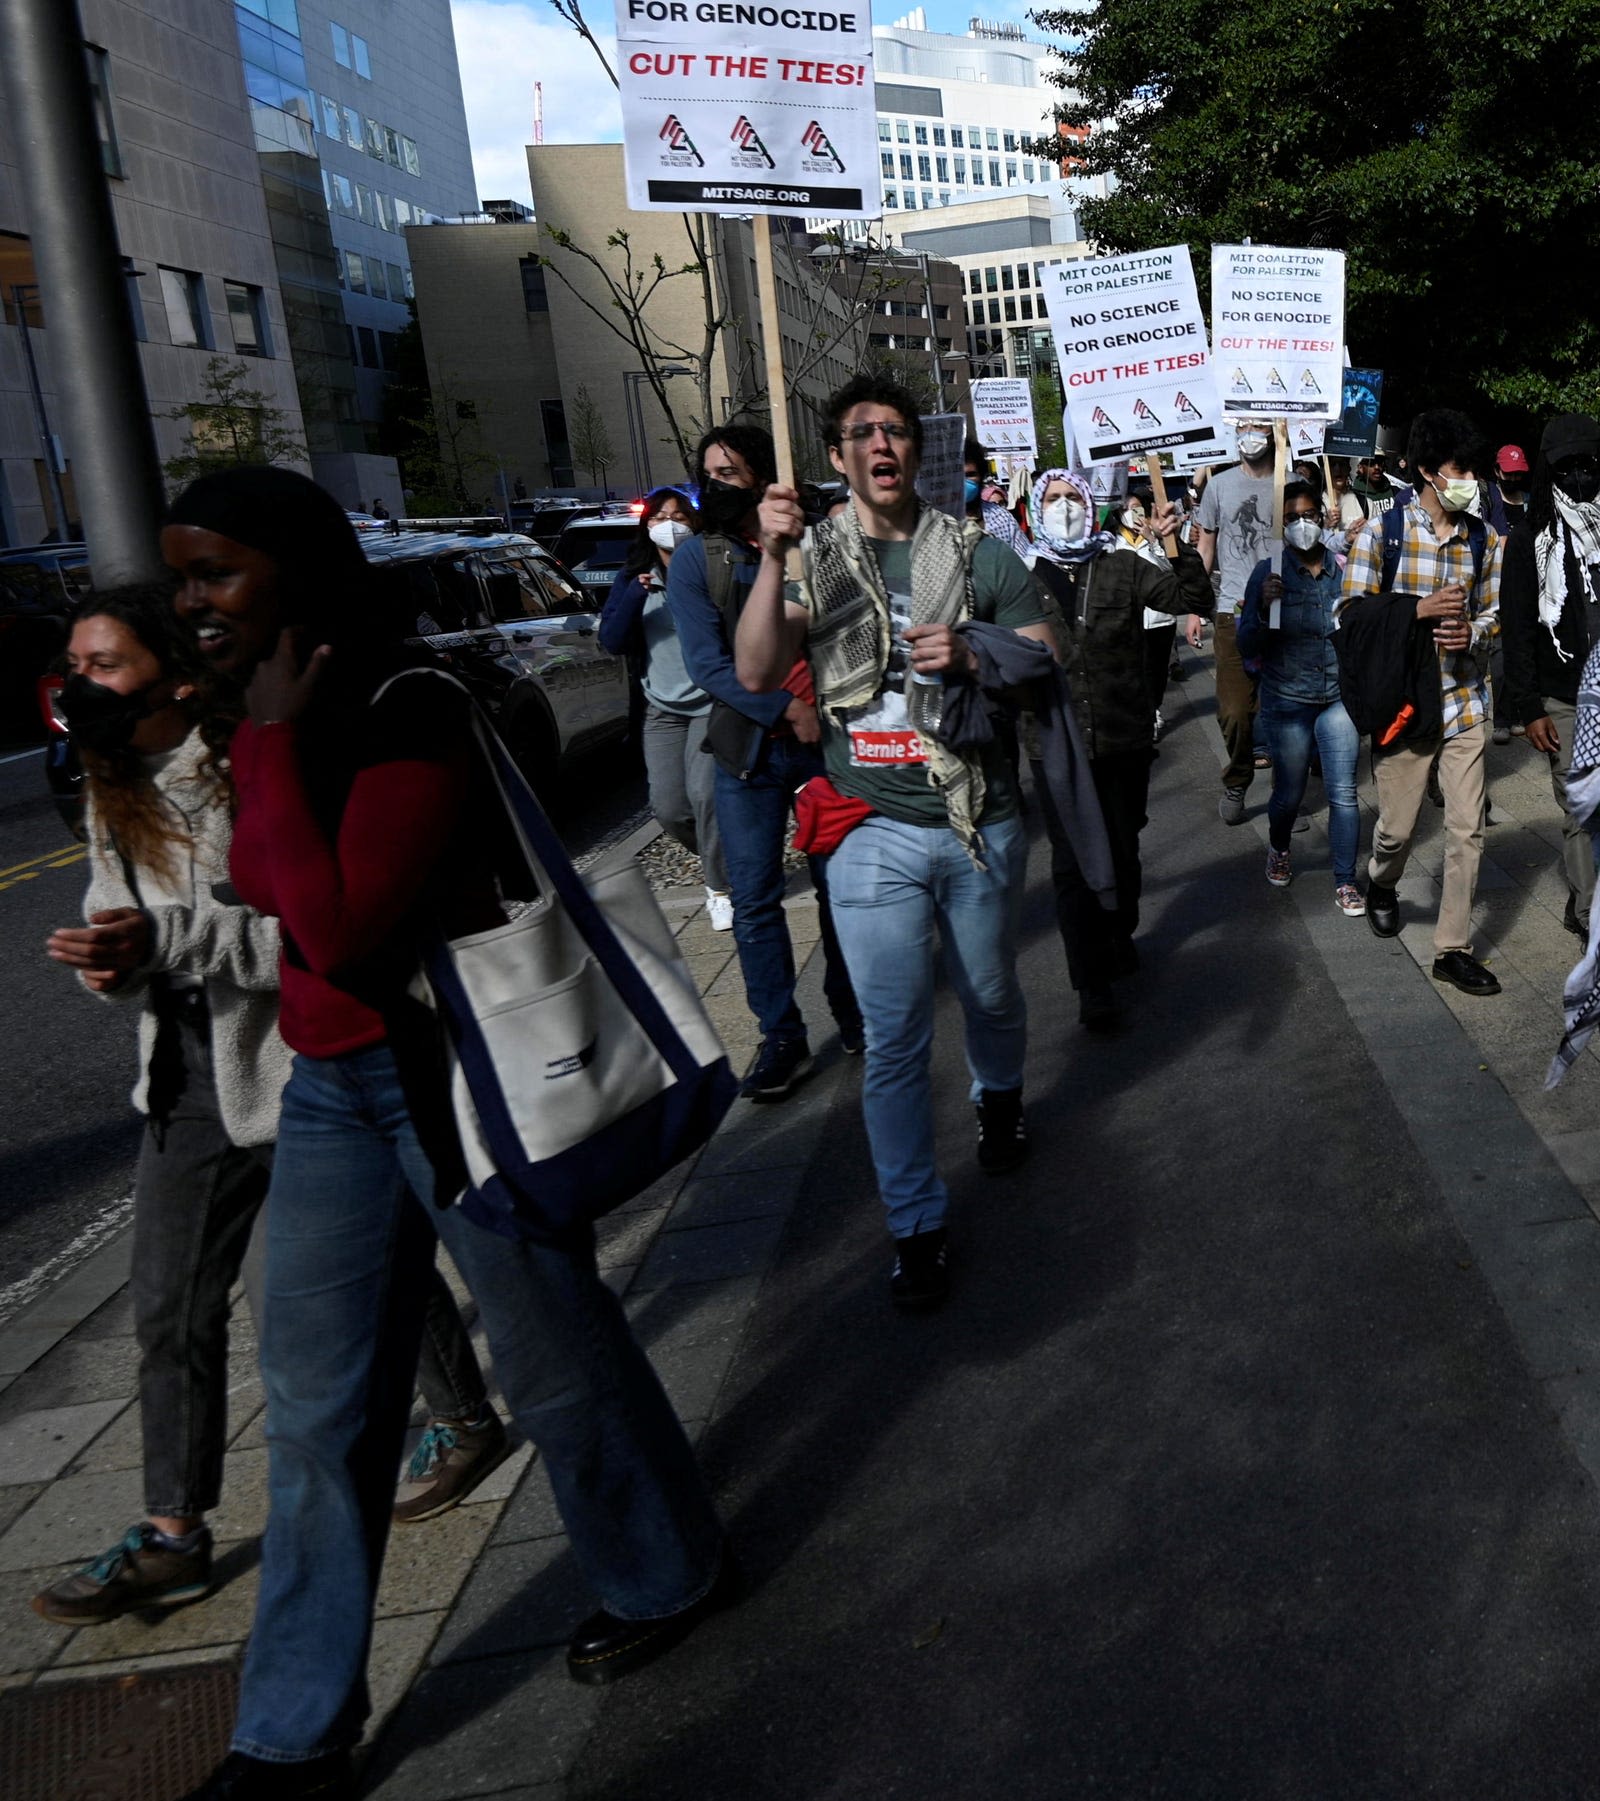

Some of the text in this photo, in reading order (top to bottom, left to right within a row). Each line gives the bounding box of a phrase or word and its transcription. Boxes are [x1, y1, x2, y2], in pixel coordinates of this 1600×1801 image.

[629, 1, 857, 33] FOR GENOCIDE
[629, 53, 865, 87] CUT THE TIES!
[702, 186, 810, 203] MITSAGE.ORG
[1059, 254, 1173, 282] MIT COALITION
[1230, 253, 1324, 265] MIT COALITION
[1232, 266, 1321, 277] FOR PALESTINE
[1065, 270, 1173, 296] FOR PALESTINE
[1231, 290, 1322, 303] NO SCIENCE
[1070, 299, 1180, 328] NO SCIENCE
[1222, 311, 1332, 324] FOR GENOCIDE
[1064, 322, 1197, 355] FOR GENOCIDE
[1220, 337, 1335, 352] CUT THE TIES!
[1069, 352, 1205, 387] CUT THE TIES!
[1121, 434, 1185, 453] MITSAGE.ORG
[584, 571, 609, 581] STATE
[855, 738, 906, 758] Bernie
